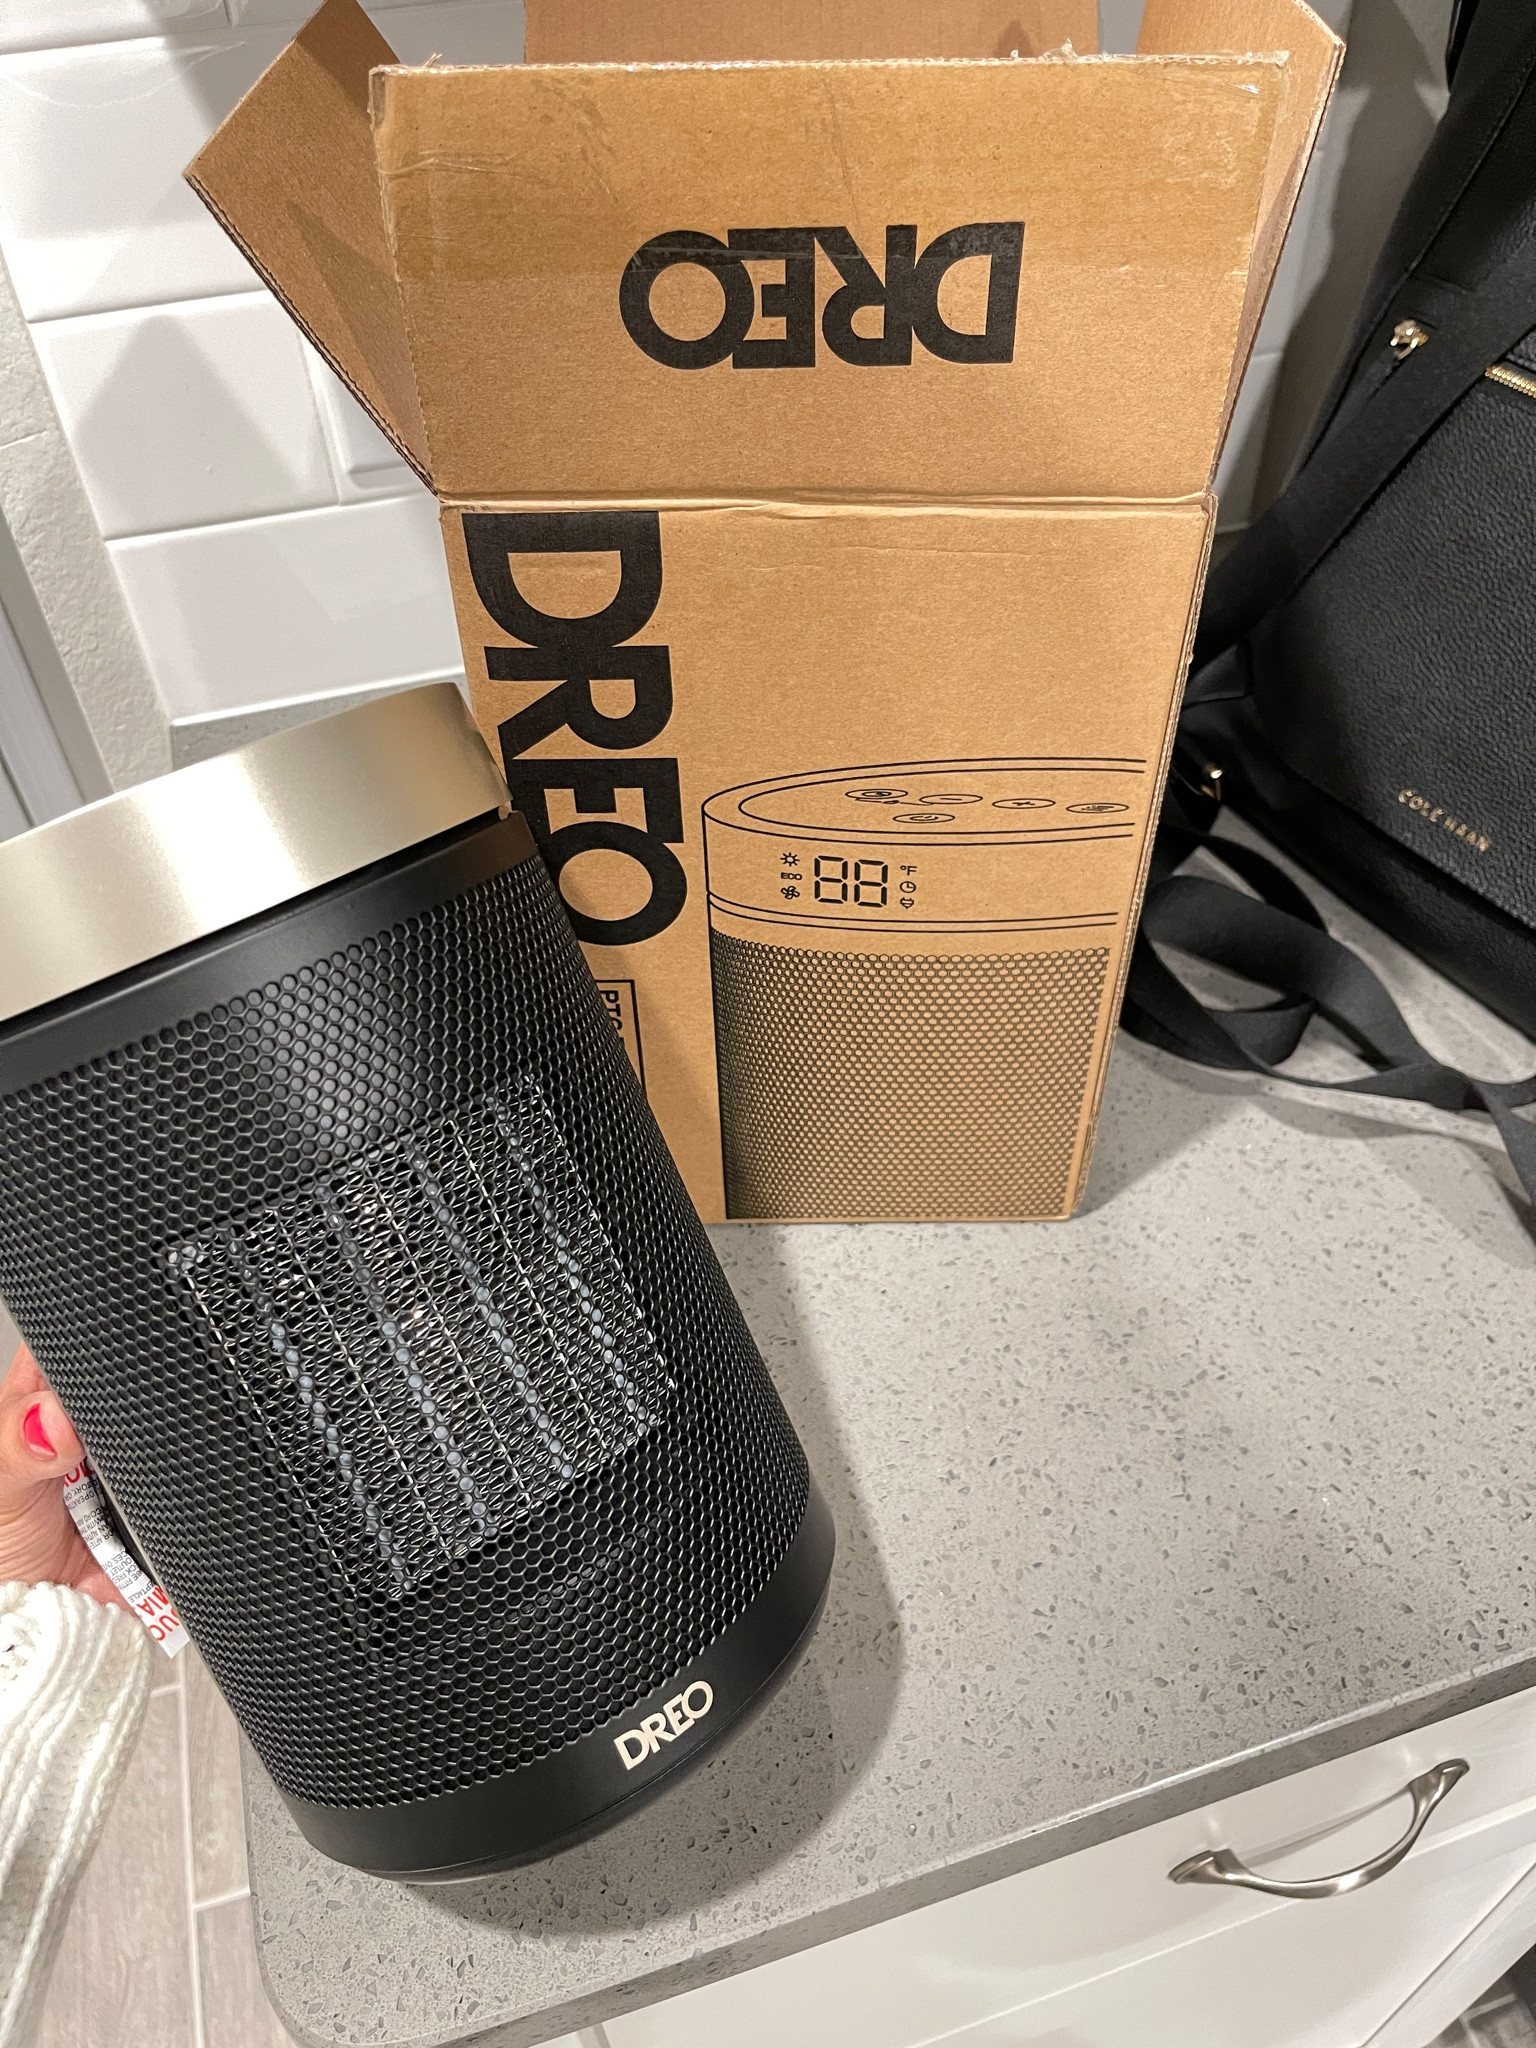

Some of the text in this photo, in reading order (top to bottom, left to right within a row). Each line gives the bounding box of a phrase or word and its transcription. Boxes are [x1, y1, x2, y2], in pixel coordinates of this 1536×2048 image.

[619, 221, 1025, 370] DREO
[462, 511, 687, 946] DREO
[1398, 788, 1445, 823] COLE
[780, 872, 802, 881] ECO
[613, 1680, 714, 1771] DREO
